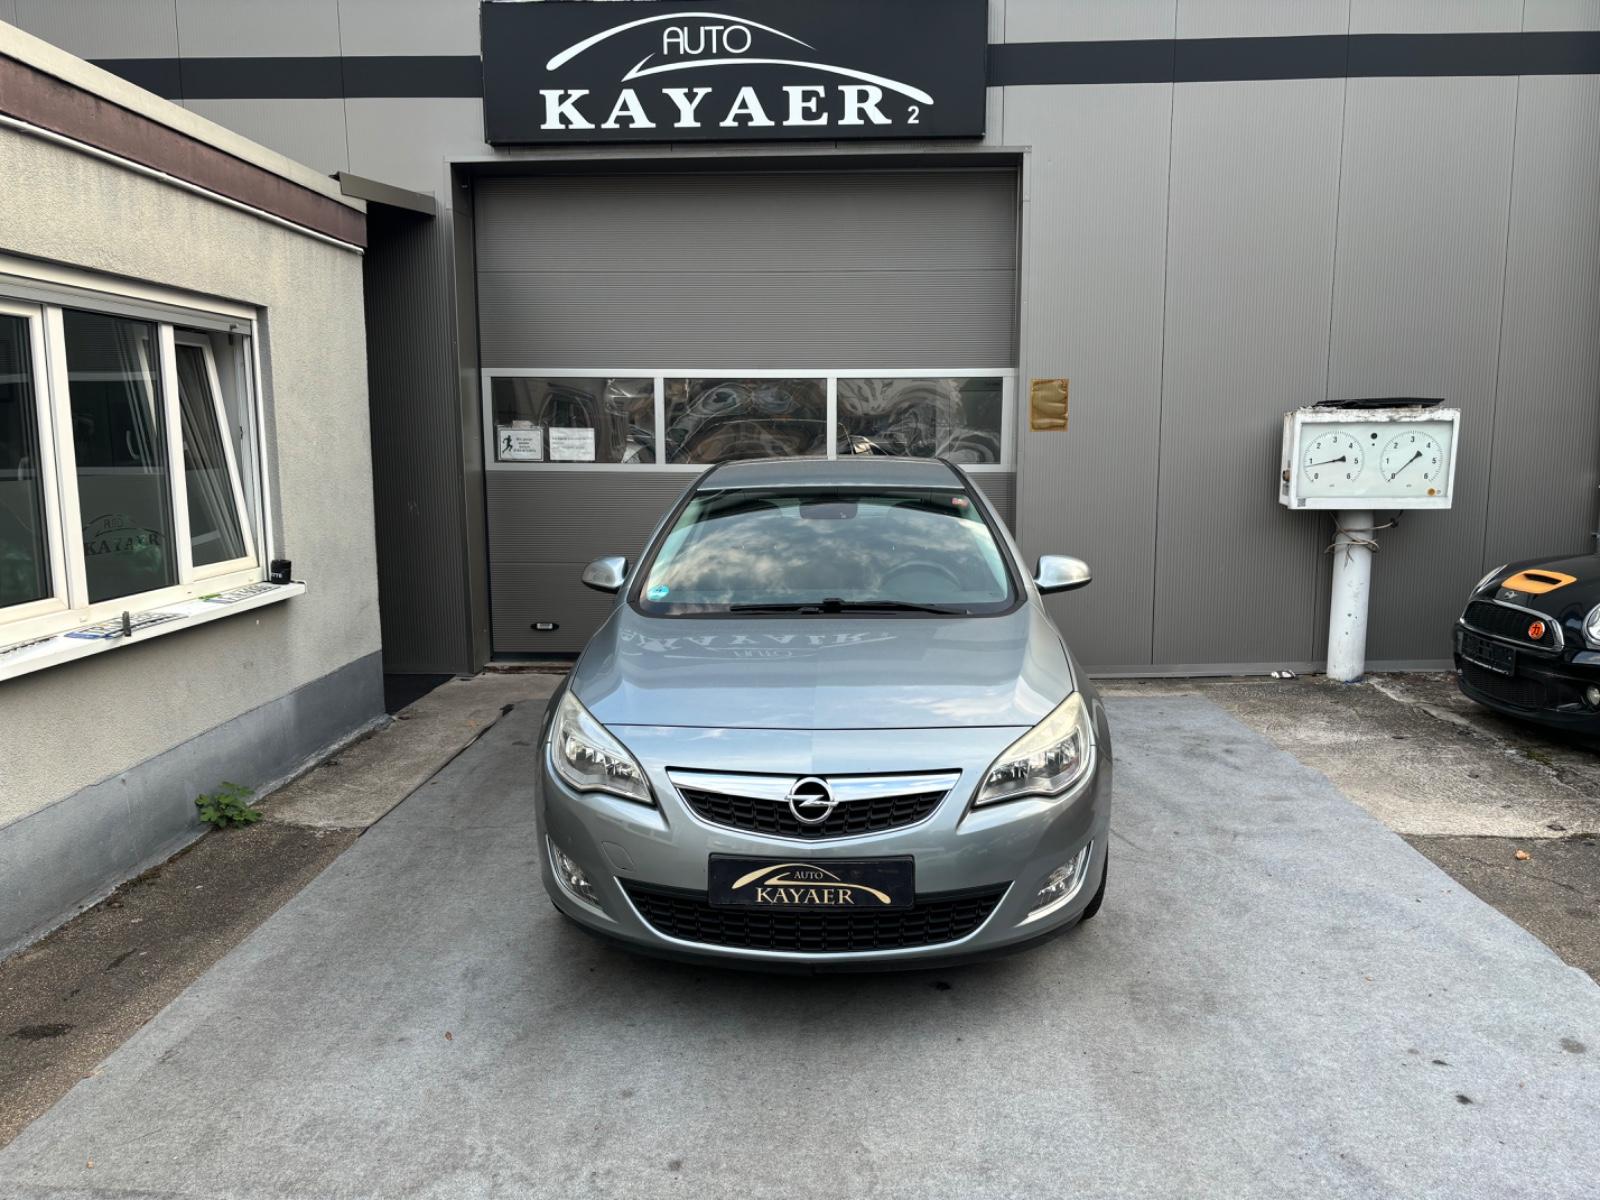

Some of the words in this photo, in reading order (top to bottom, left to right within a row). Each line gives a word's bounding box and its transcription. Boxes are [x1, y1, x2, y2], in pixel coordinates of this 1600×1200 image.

[663, 25, 752, 56] AUTO
[539, 84, 892, 131] KAYAER
[907, 105, 920, 125] 2
[1316, 442, 1321, 450] 2
[1354, 457, 1359, 465] 5
[1393, 442, 1399, 450] 2
[1410, 435, 1415, 443] 3
[1432, 457, 1437, 465] 5
[793, 871, 824, 880] AUTO
[756, 887, 854, 905] KAYAER
